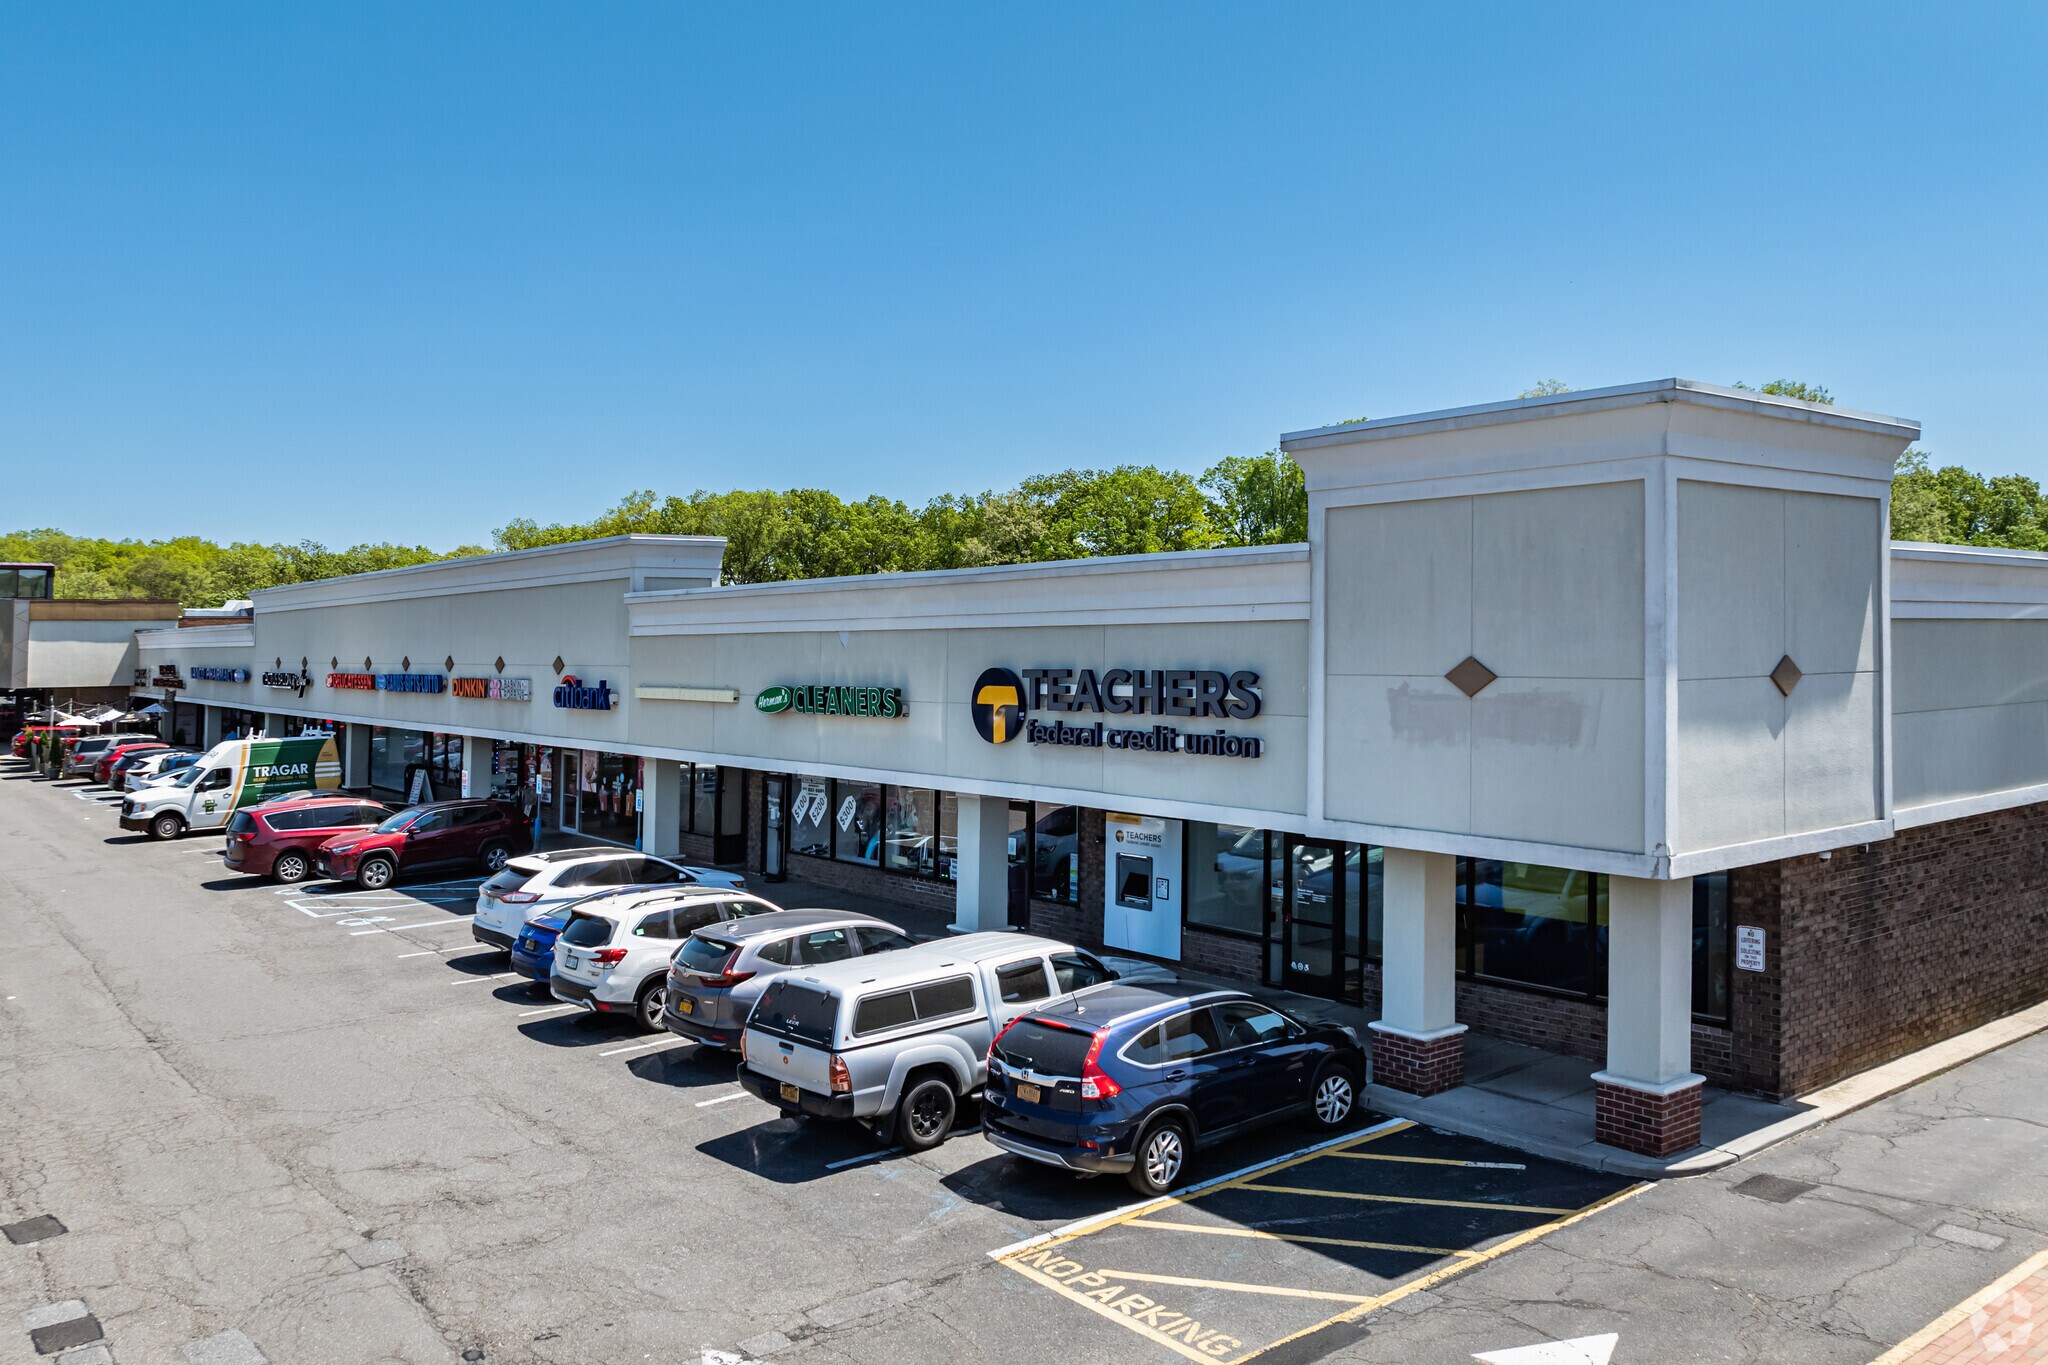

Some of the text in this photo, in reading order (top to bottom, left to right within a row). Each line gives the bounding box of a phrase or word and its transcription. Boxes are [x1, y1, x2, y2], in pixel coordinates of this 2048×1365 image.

[332, 673, 374, 690] DELICATESSEN
[452, 678, 488, 698] DUNKIN'
[553, 679, 610, 710] citibank
[758, 689, 788, 709] Herman's
[793, 685, 900, 719] CLEANERS
[1022, 669, 1260, 719] TEACHERS
[1025, 719, 1261, 758] federal credit union
[253, 763, 308, 777] TRAGAR
[1126, 831, 1162, 843] TEACHERS
[1740, 947, 1761, 956] SOLICITING
[1020, 1249, 1243, 1357] NO PARKING
